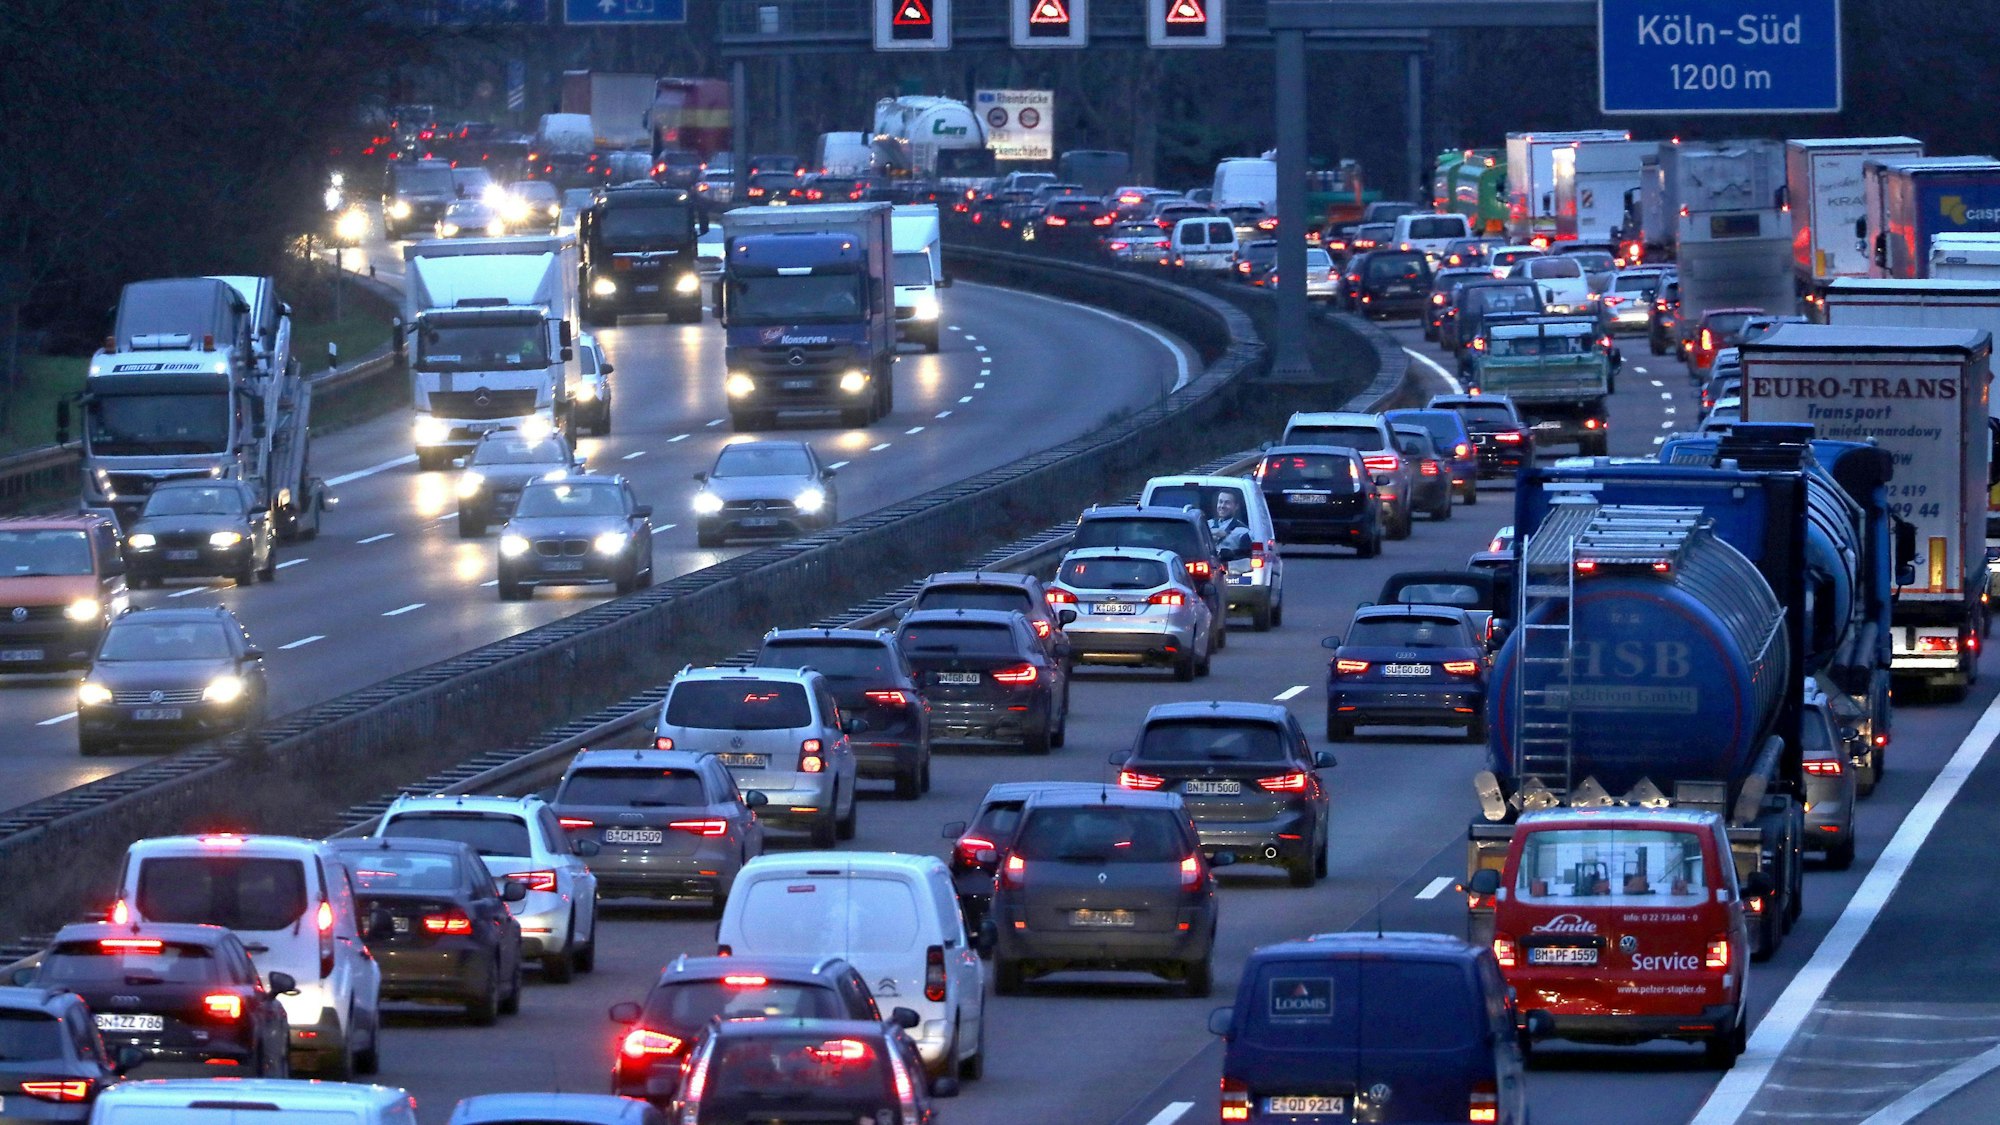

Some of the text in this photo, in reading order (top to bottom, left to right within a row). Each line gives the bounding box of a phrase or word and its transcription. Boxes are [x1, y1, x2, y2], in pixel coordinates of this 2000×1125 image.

[1637, 14, 1801, 46] Köln-Süd
[1670, 63, 1771, 90] 1200 m
[993, 145, 1048, 156] ckenschäden
[781, 335, 828, 344] Konserven
[119, 364, 157, 372] LIMITED
[1751, 377, 1957, 399] EURO-TRANS
[1807, 403, 1892, 423] Transport
[1901, 485, 1927, 497] 419
[1918, 503, 1940, 518] 44
[1558, 640, 1692, 678] HSB
[1187, 783, 1199, 792] BN
[1217, 783, 1239, 793] 5000
[620, 831, 634, 841] CH
[636, 831, 661, 841] 1509
[1532, 914, 1597, 933] Linde
[1623, 914, 1640, 922] Info:
[1535, 950, 1597, 961] BM PF 1559
[1631, 952, 1699, 970] Service
[1617, 985, 1707, 994] www.pelzer-stapler.de
[1275, 997, 1326, 1010] LOOMIS
[120, 1016, 136, 1028] ZZ
[140, 1016, 162, 1029] 786
[1271, 1098, 1281, 1111] E
[1308, 1098, 1341, 1112] 9214
